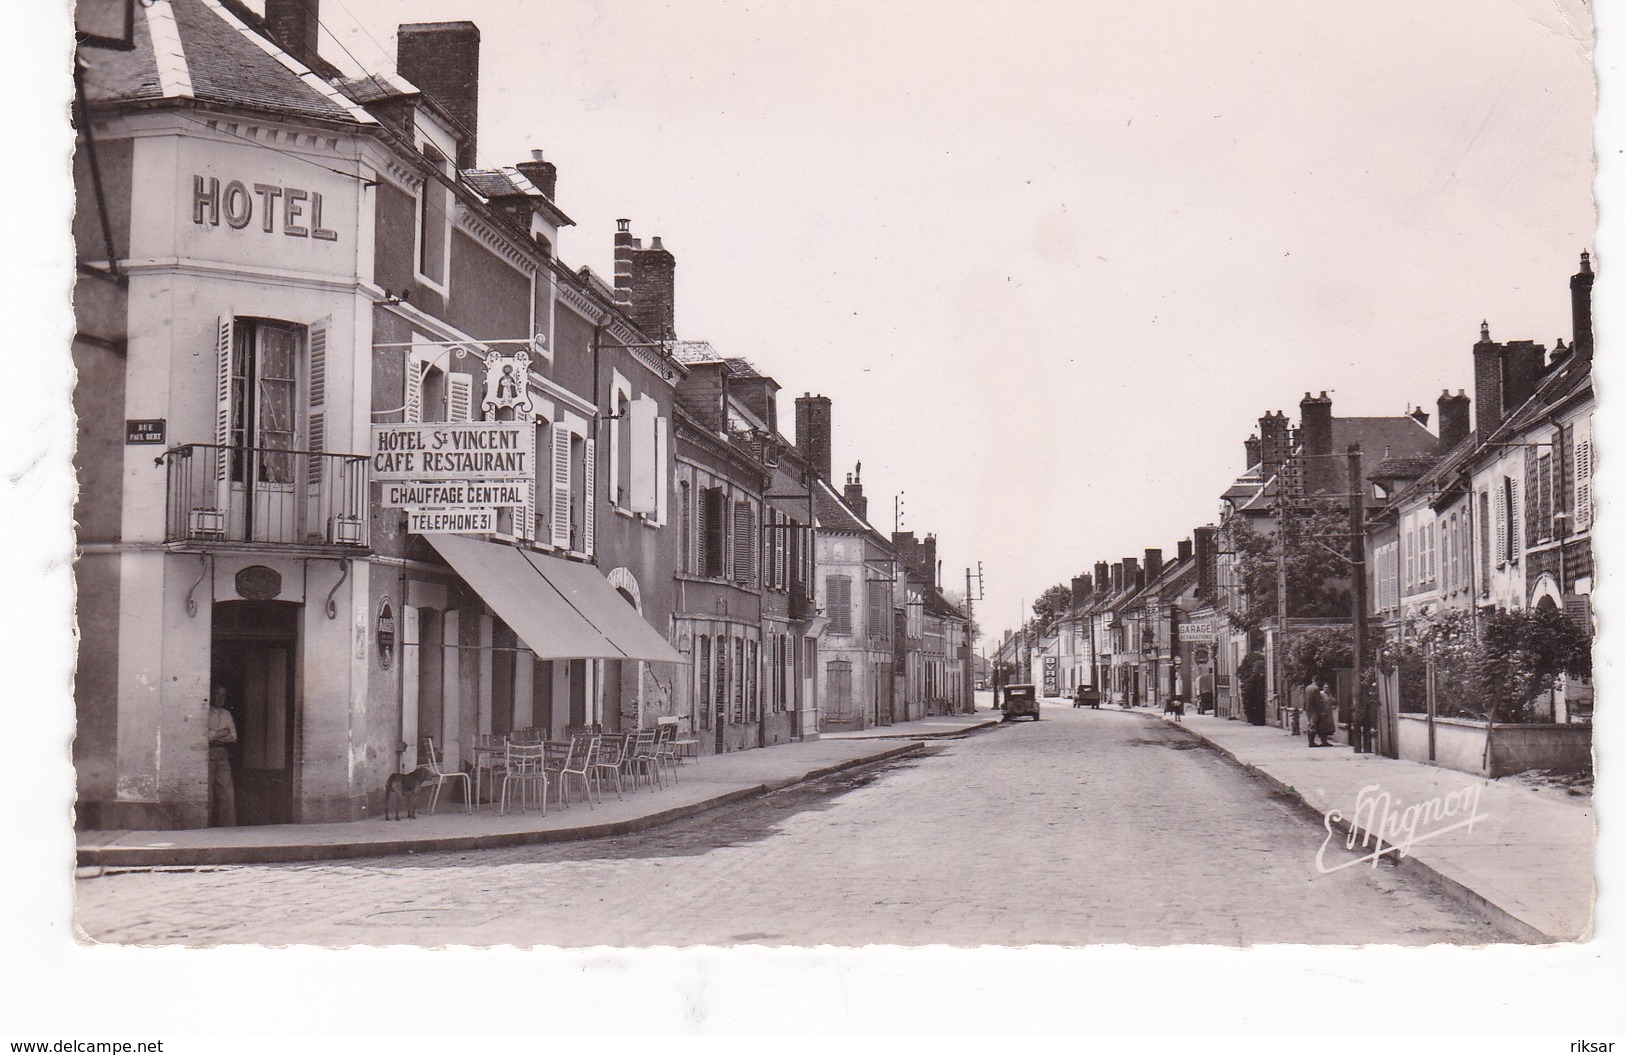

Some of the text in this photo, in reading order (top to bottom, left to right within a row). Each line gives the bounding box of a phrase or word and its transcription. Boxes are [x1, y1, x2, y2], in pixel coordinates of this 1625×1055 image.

[193, 174, 338, 242] HOTEL
[138, 423, 154, 431] RUE
[378, 429, 426, 451] HÔTEL
[450, 430, 520, 450] VINCENT
[373, 451, 526, 472] CAFÉ RESTAURANT
[390, 487, 523, 504] CHAUFFAGE CENTRAL
[412, 513, 491, 530] TÉLÉPHONE 31
[1180, 624, 1212, 634] GARAGE
